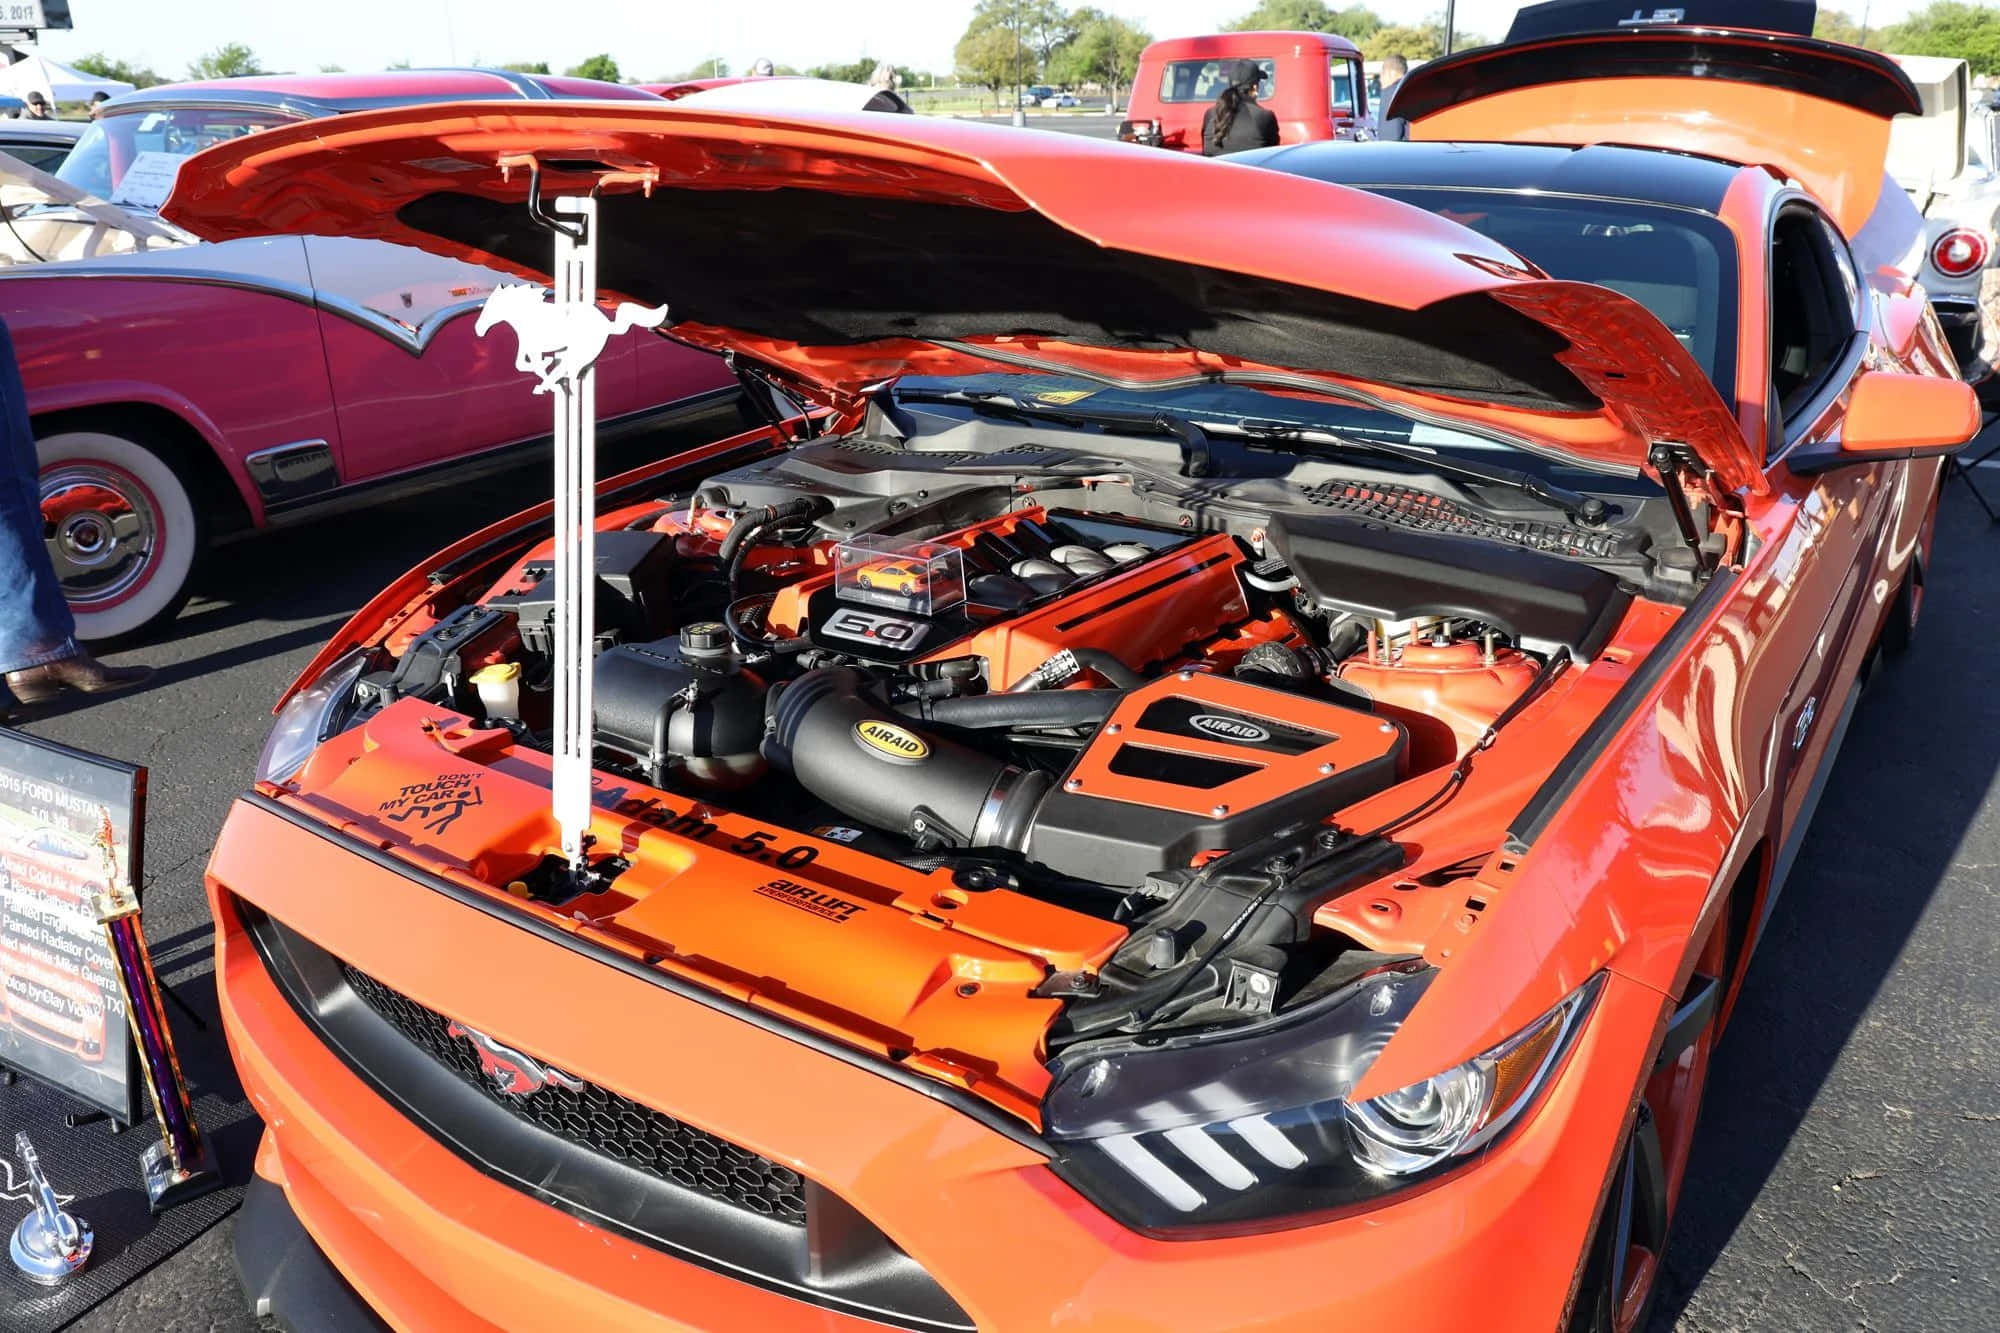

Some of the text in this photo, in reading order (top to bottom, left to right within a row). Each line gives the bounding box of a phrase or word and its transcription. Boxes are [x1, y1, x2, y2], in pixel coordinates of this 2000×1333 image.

[11, 5, 33, 20] 2017
[834, 614, 914, 642] 5.0
[864, 726, 919, 752] AIRAID
[1199, 718, 1260, 738] AIRAID
[438, 773, 485, 781] DON'T
[22, 781, 53, 803] FORD
[400, 780, 471, 797] TOUCH
[379, 789, 455, 811] MY CAR
[592, 786, 819, 870] Adam 5.0
[3, 913, 115, 971] Painted Radiator Cover
[81, 964, 118, 993] Guerra
